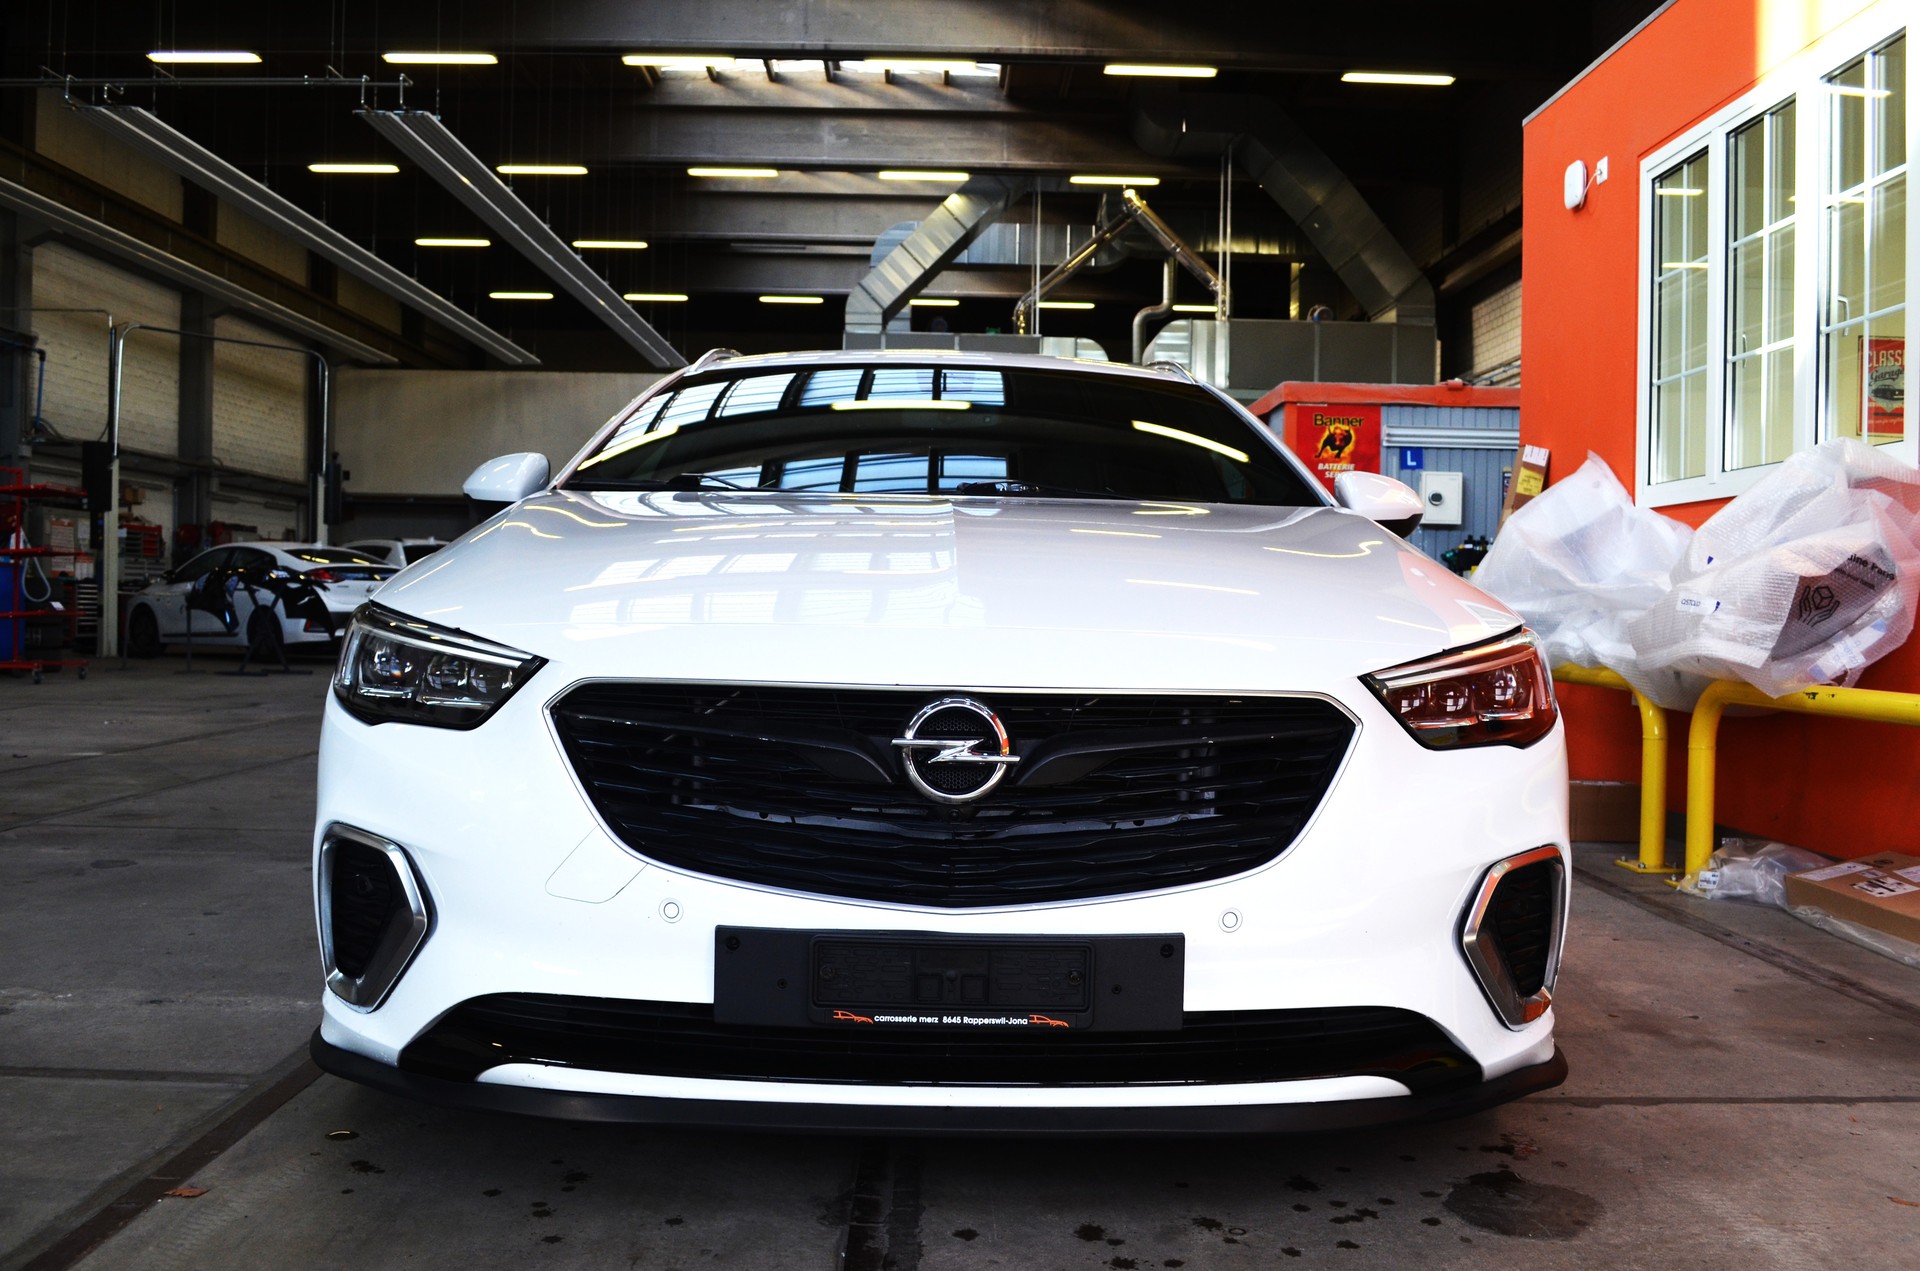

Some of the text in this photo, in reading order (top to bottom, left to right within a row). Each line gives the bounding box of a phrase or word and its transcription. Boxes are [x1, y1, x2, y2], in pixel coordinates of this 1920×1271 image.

[1314, 413, 1364, 427] Banner
[1407, 450, 1417, 466] L
[1317, 462, 1356, 471] BATTERIE
[874, 1015, 918, 1023] carrosserie
[942, 1016, 962, 1024] 8645
[963, 1016, 1028, 1025] Rapperswil-Jona
